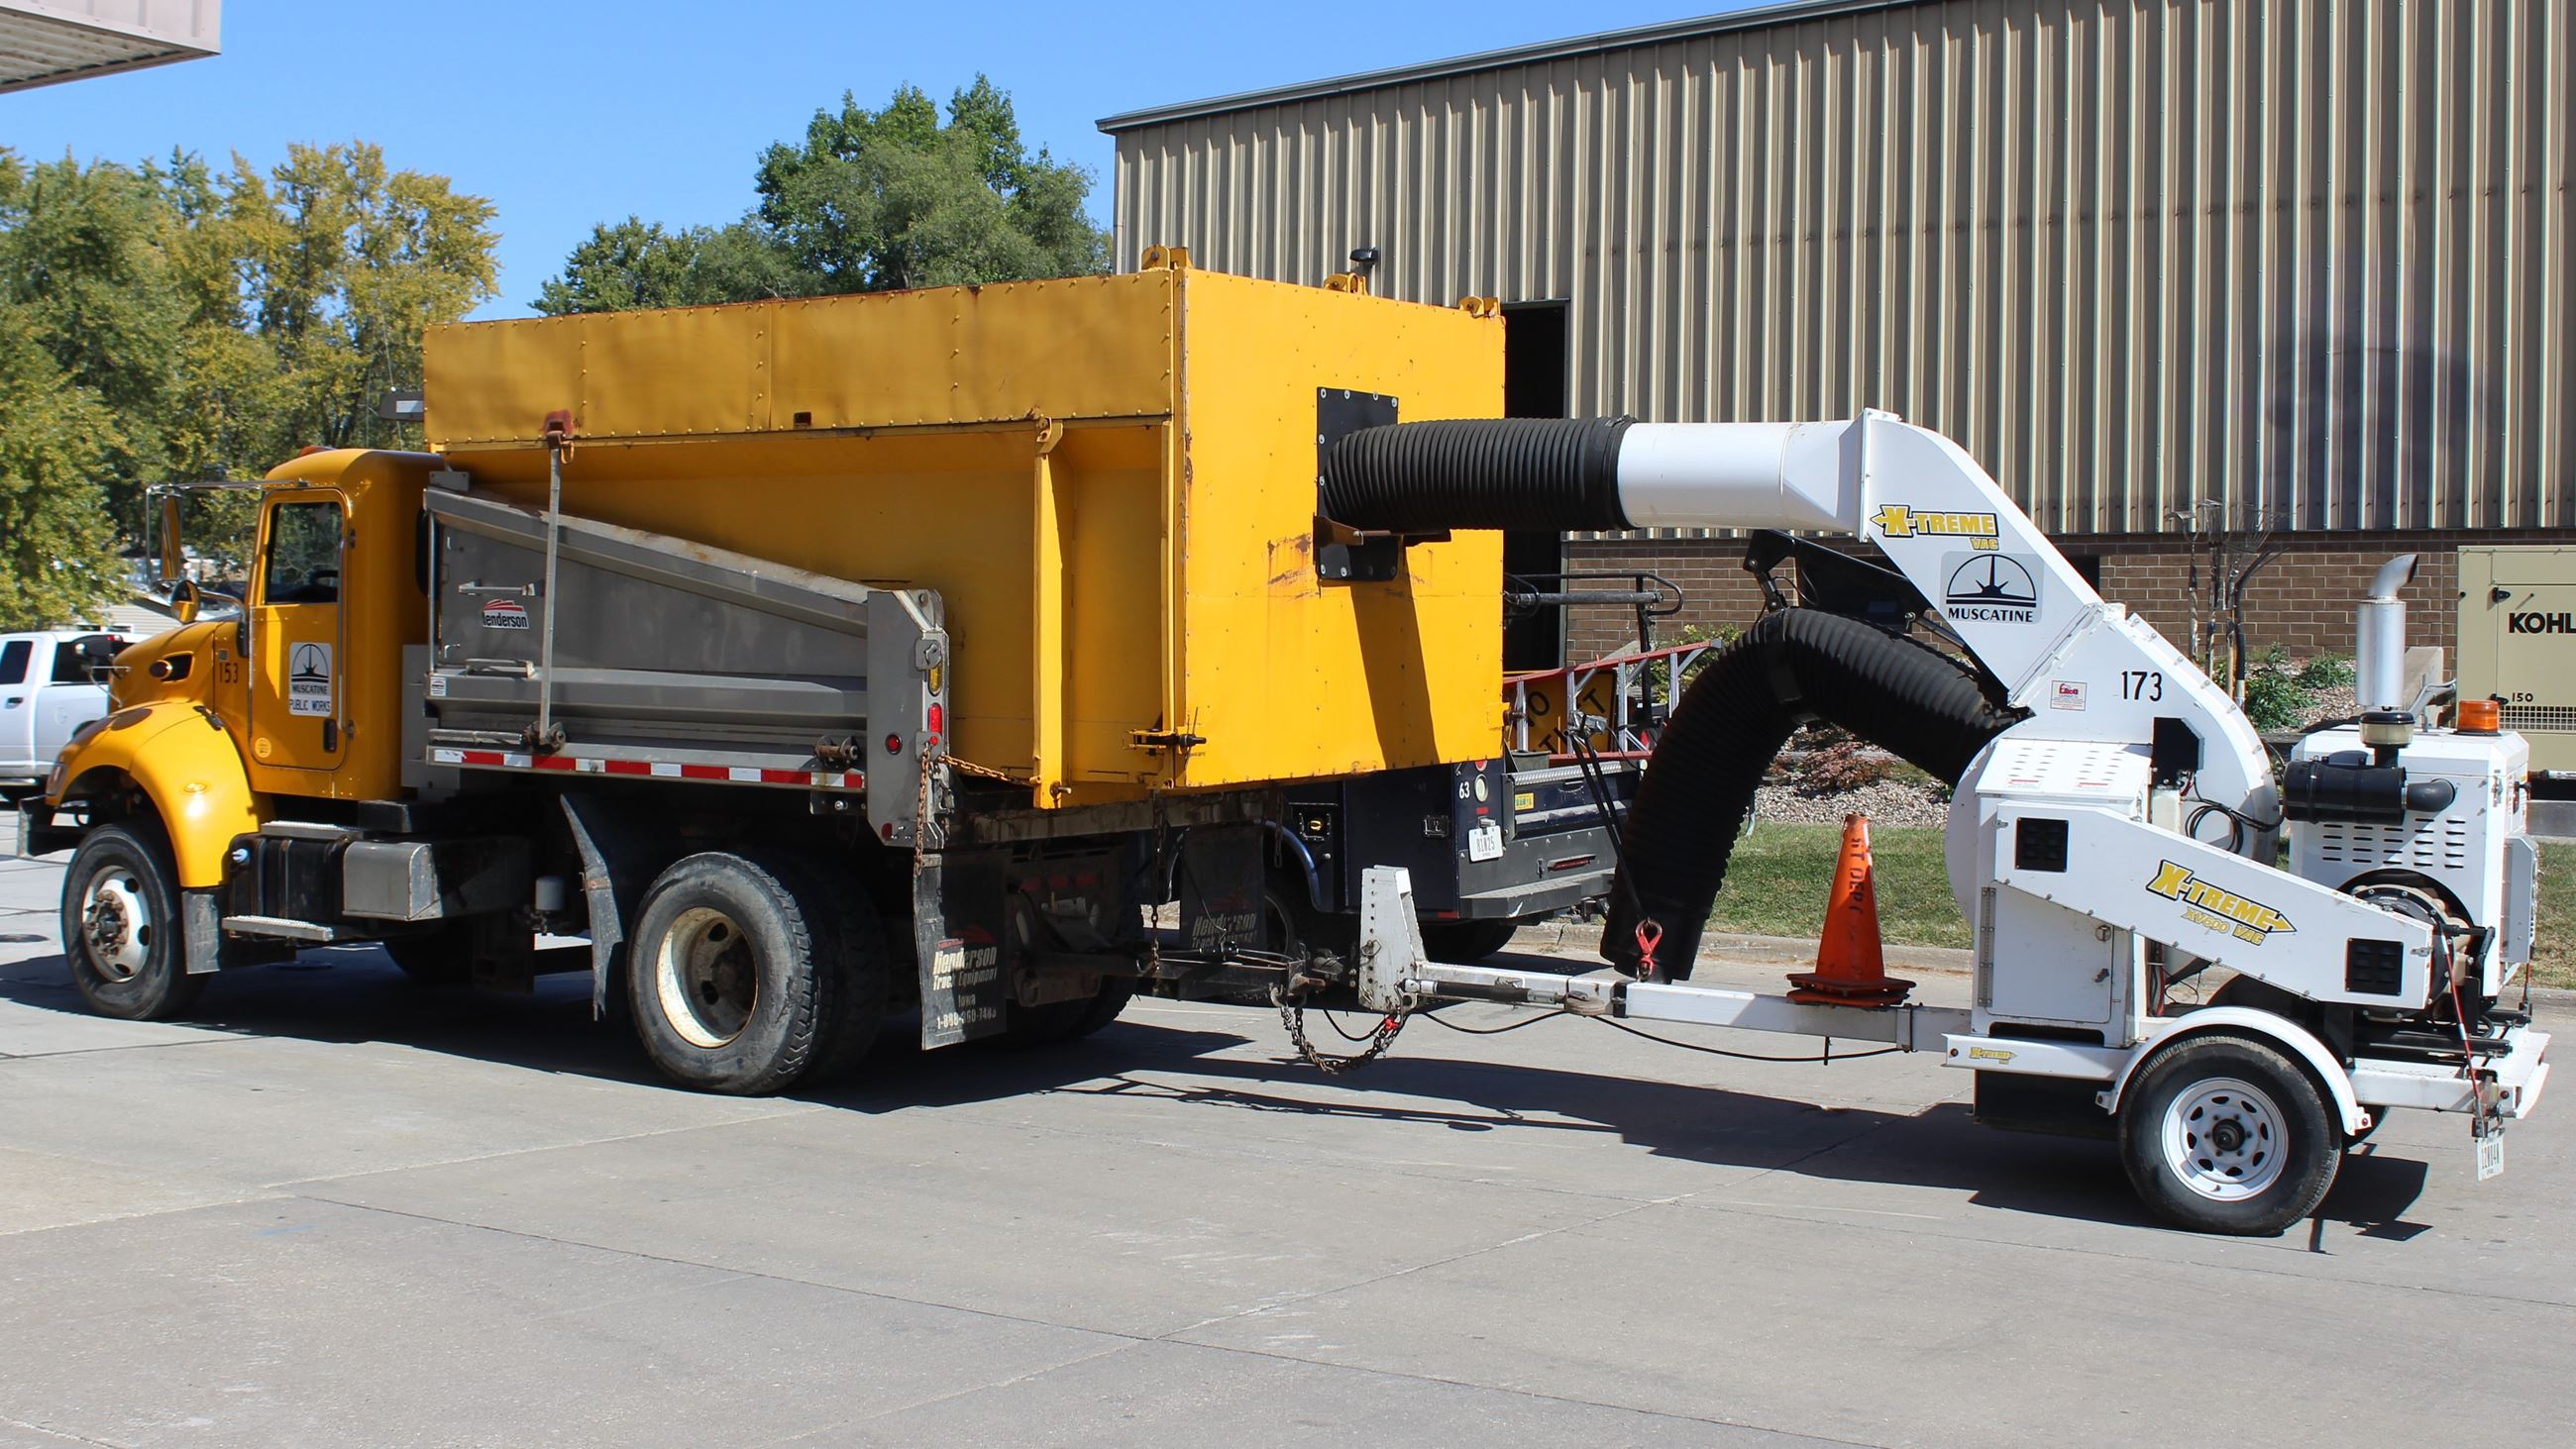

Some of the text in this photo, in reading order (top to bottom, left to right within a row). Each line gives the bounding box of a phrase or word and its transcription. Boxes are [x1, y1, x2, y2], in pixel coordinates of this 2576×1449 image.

[1878, 505, 1999, 538] X-TREME
[1970, 538, 1999, 551] VAC
[1948, 607, 2033, 623] MUSCATINE
[2509, 612, 2576, 634] KOHL
[219, 663, 238, 683] 153
[292, 684, 328, 694] MUSCATINE
[2121, 671, 2163, 701] 173
[289, 698, 330, 712] PUBLIC WORKS
[2512, 692, 2533, 702] 150
[1458, 781, 1470, 799] 63
[2146, 860, 2289, 933] X-TREME
[2232, 923, 2267, 946] VAC
[933, 947, 997, 975] Henderson
[958, 993, 976, 1007] Iowa
